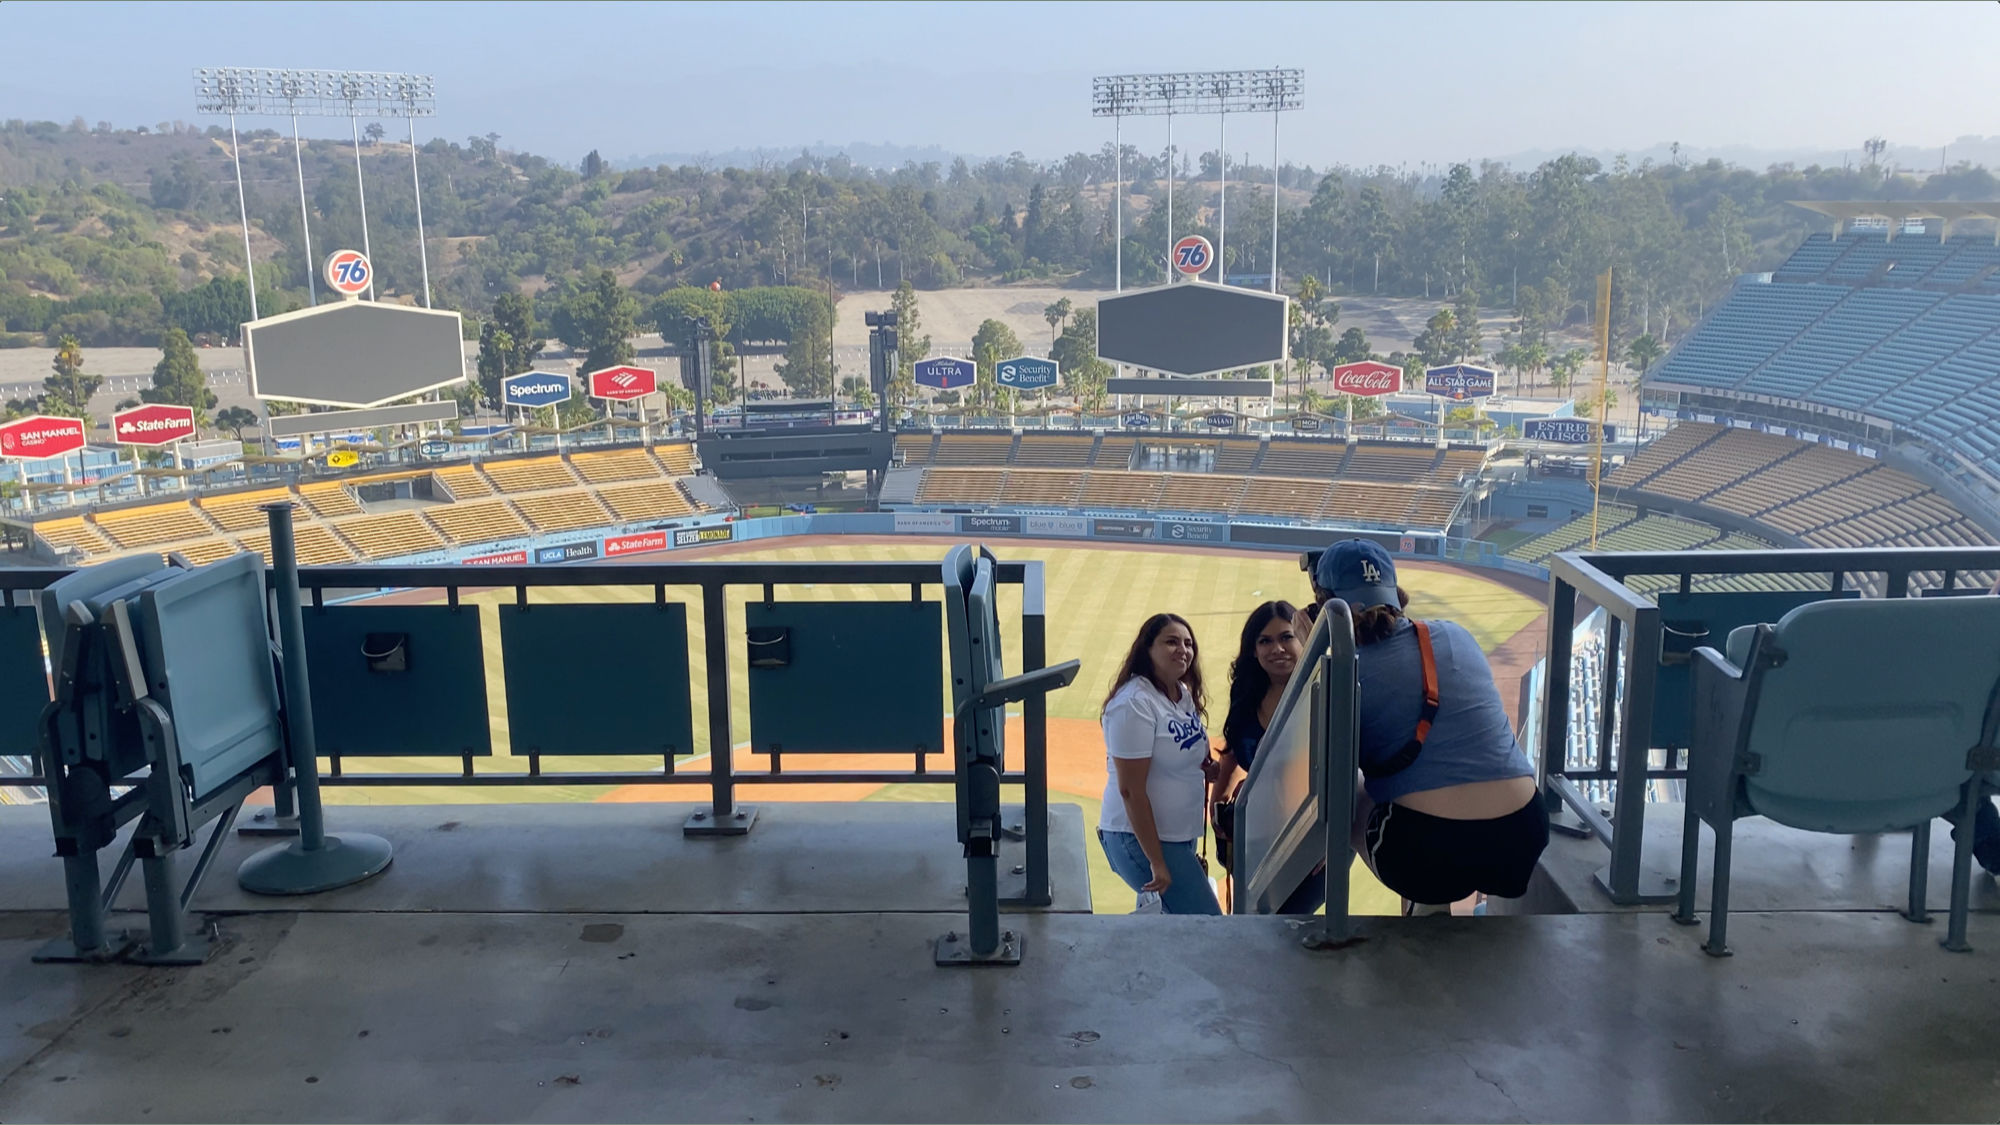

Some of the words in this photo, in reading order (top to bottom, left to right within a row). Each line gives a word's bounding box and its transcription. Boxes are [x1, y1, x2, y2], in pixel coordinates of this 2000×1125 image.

[1178, 243, 1206, 267] 76
[336, 259, 367, 284] 76
[927, 367, 962, 376] ULTRA
[1019, 365, 1051, 375] Security
[1019, 374, 1047, 383] Benefit
[1338, 370, 1395, 389] Coca-Cola
[1428, 377, 1443, 386] ALL
[1445, 377, 1465, 387] STAR
[1466, 378, 1493, 388] GAME
[509, 383, 562, 397] Spectrum
[1208, 417, 1232, 425] DASANI
[20, 431, 40, 441] SAN
[41, 427, 80, 438] MANUEL
[1531, 430, 1591, 442] JALISCO
[971, 517, 1009, 527] Spectrum
[543, 551, 561, 559] UCLA
[565, 546, 593, 557] Health
[494, 554, 524, 565] MANUEL
[1361, 560, 1381, 582] LA
